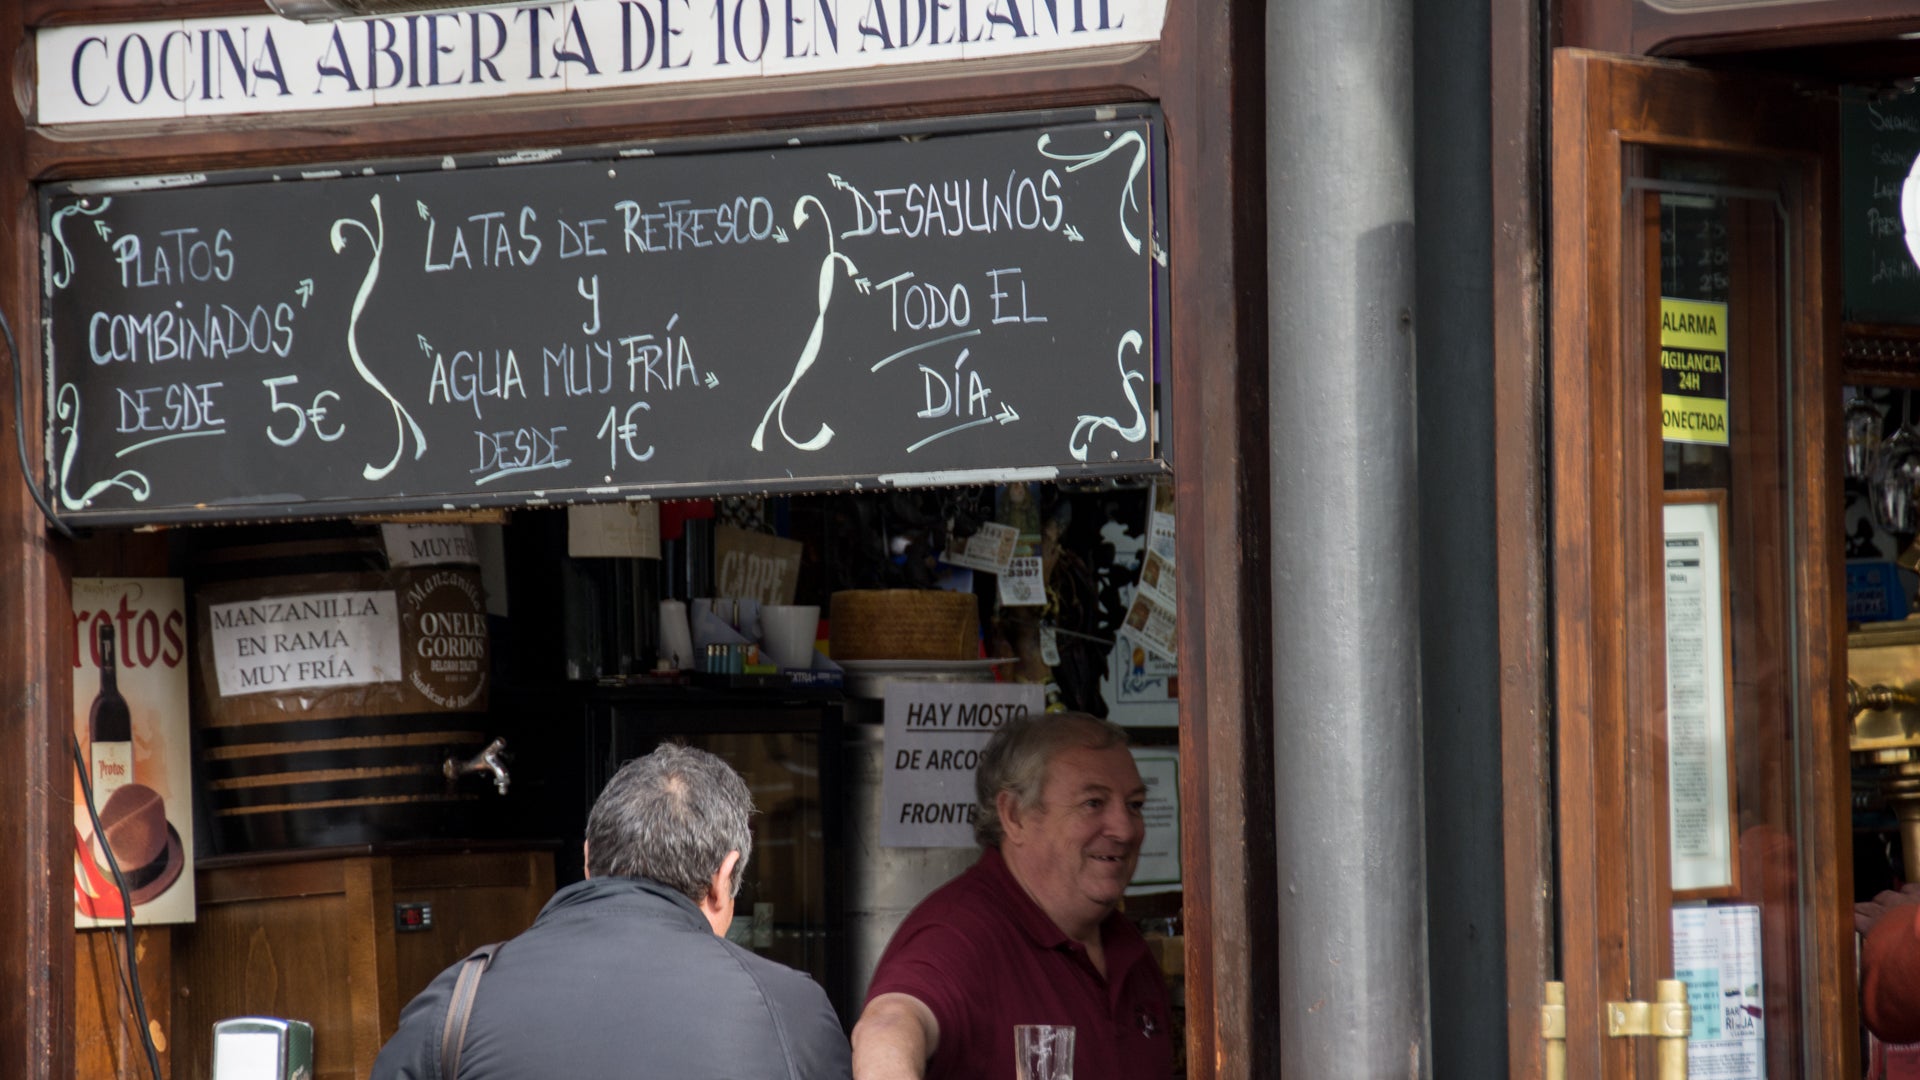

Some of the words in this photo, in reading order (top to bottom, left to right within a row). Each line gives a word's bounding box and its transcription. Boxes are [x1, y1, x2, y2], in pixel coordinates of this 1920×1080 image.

[71, 25, 293, 107] COCINA
[313, 6, 602, 95] ABIERTA
[618, 0, 693, 73] DE
[710, 0, 771, 66] 10
[783, 0, 839, 59] EN
[841, 169, 1063, 239] DESAYUNOS
[425, 206, 542, 272] LATAS
[558, 218, 607, 259] DE
[615, 196, 773, 253] REFRESCO
[112, 227, 234, 288] PLATOS
[875, 271, 971, 332] TODO
[986, 268, 1047, 325] EL
[1662, 312, 1717, 336] ALARMA
[428, 348, 527, 420] AGUA
[543, 340, 612, 397] MUY
[619, 313, 699, 393] FRÍA
[917, 348, 992, 418] DÍA
[1678, 371, 1701, 391] 24H
[115, 381, 226, 433] DESDE
[262, 374, 345, 447] 5€
[1662, 408, 1725, 432] ONECTADA
[470, 425, 569, 475] DESDE
[596, 401, 655, 471] 1€
[410, 537, 452, 559] MUY
[213, 597, 379, 630] MANZANILLA
[236, 635, 267, 657] EN
[273, 630, 350, 653] RAMA
[417, 636, 484, 659] GORDOS
[240, 664, 291, 688] MUY
[298, 655, 355, 681] FRÍA
[906, 702, 953, 727] HAY
[956, 703, 1029, 728] MOSTO
[98, 759, 125, 779] Protos
[895, 749, 923, 770] DE
